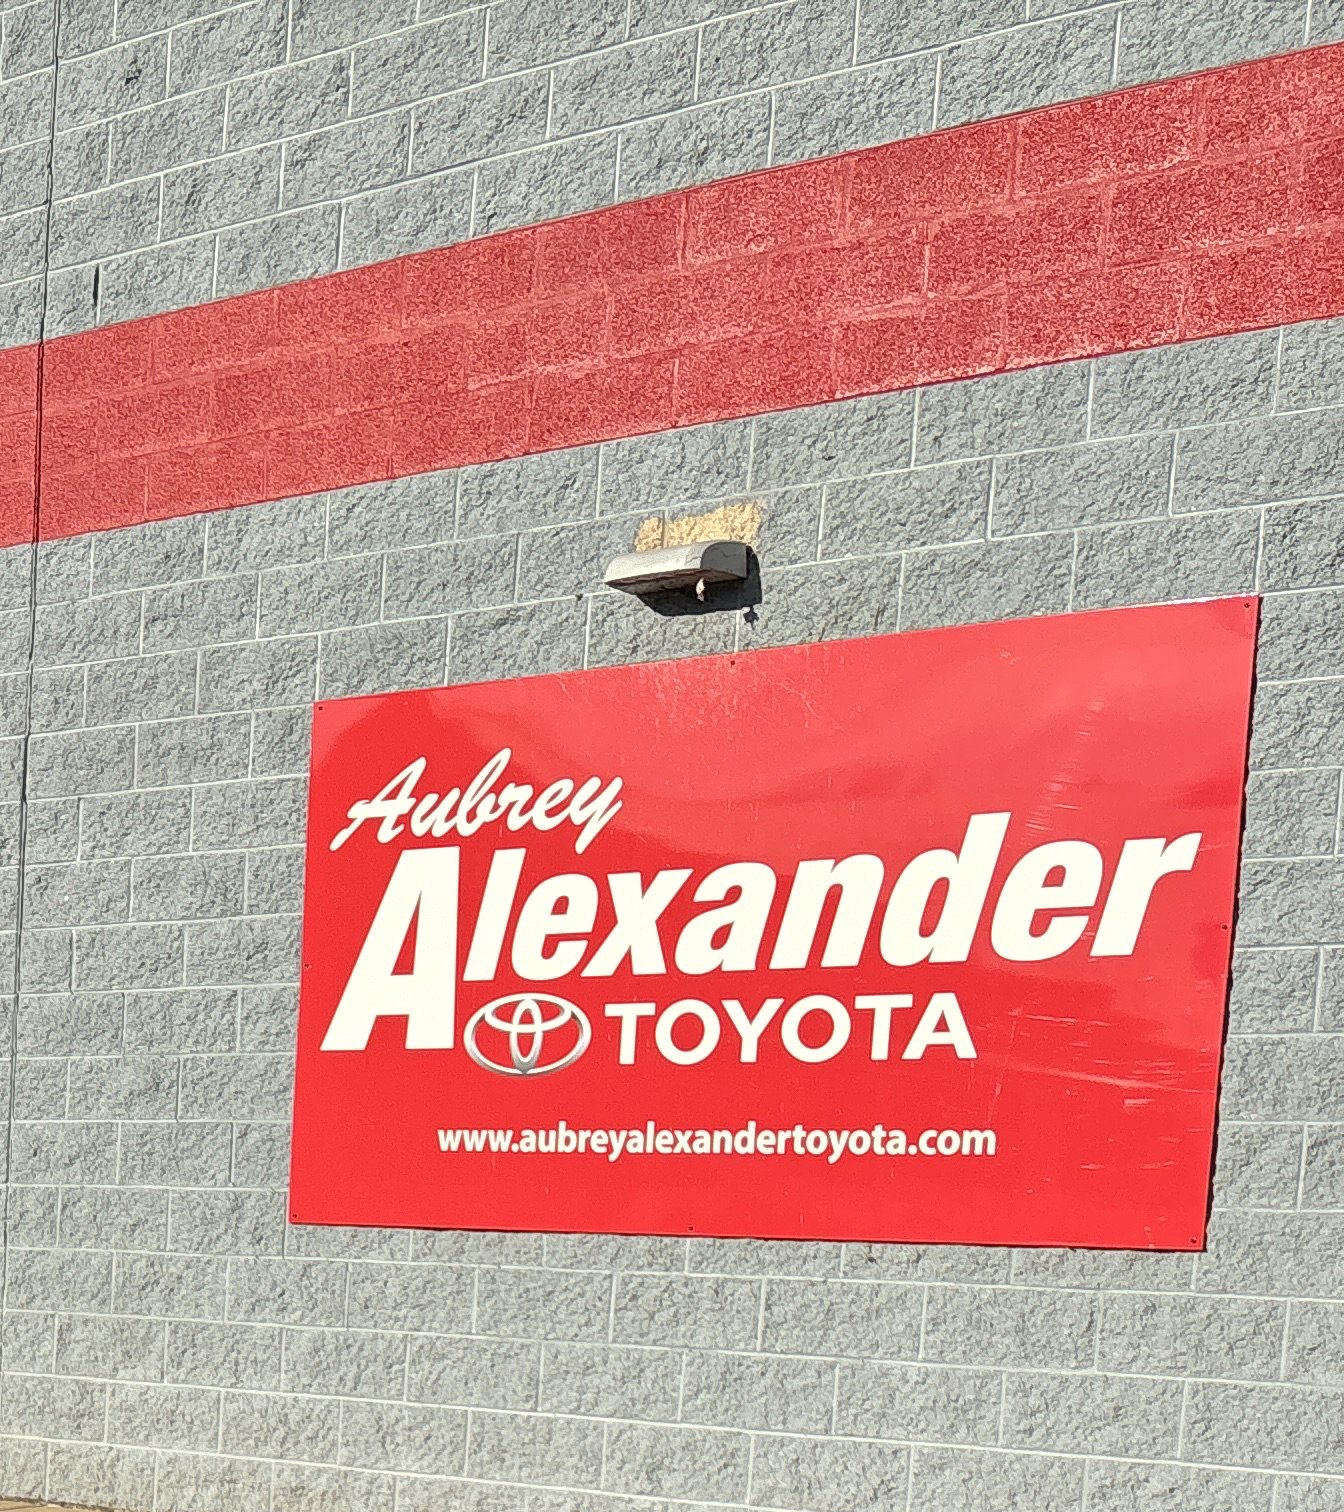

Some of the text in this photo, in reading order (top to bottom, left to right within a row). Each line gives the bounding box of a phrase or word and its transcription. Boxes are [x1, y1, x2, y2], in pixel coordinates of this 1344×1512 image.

[329, 747, 624, 855] Aubrey
[319, 811, 1203, 1051] Alexander
[604, 993, 979, 1066] TOYOTA
[436, 1119, 997, 1163] www.aubreyalexandertoyota.com
